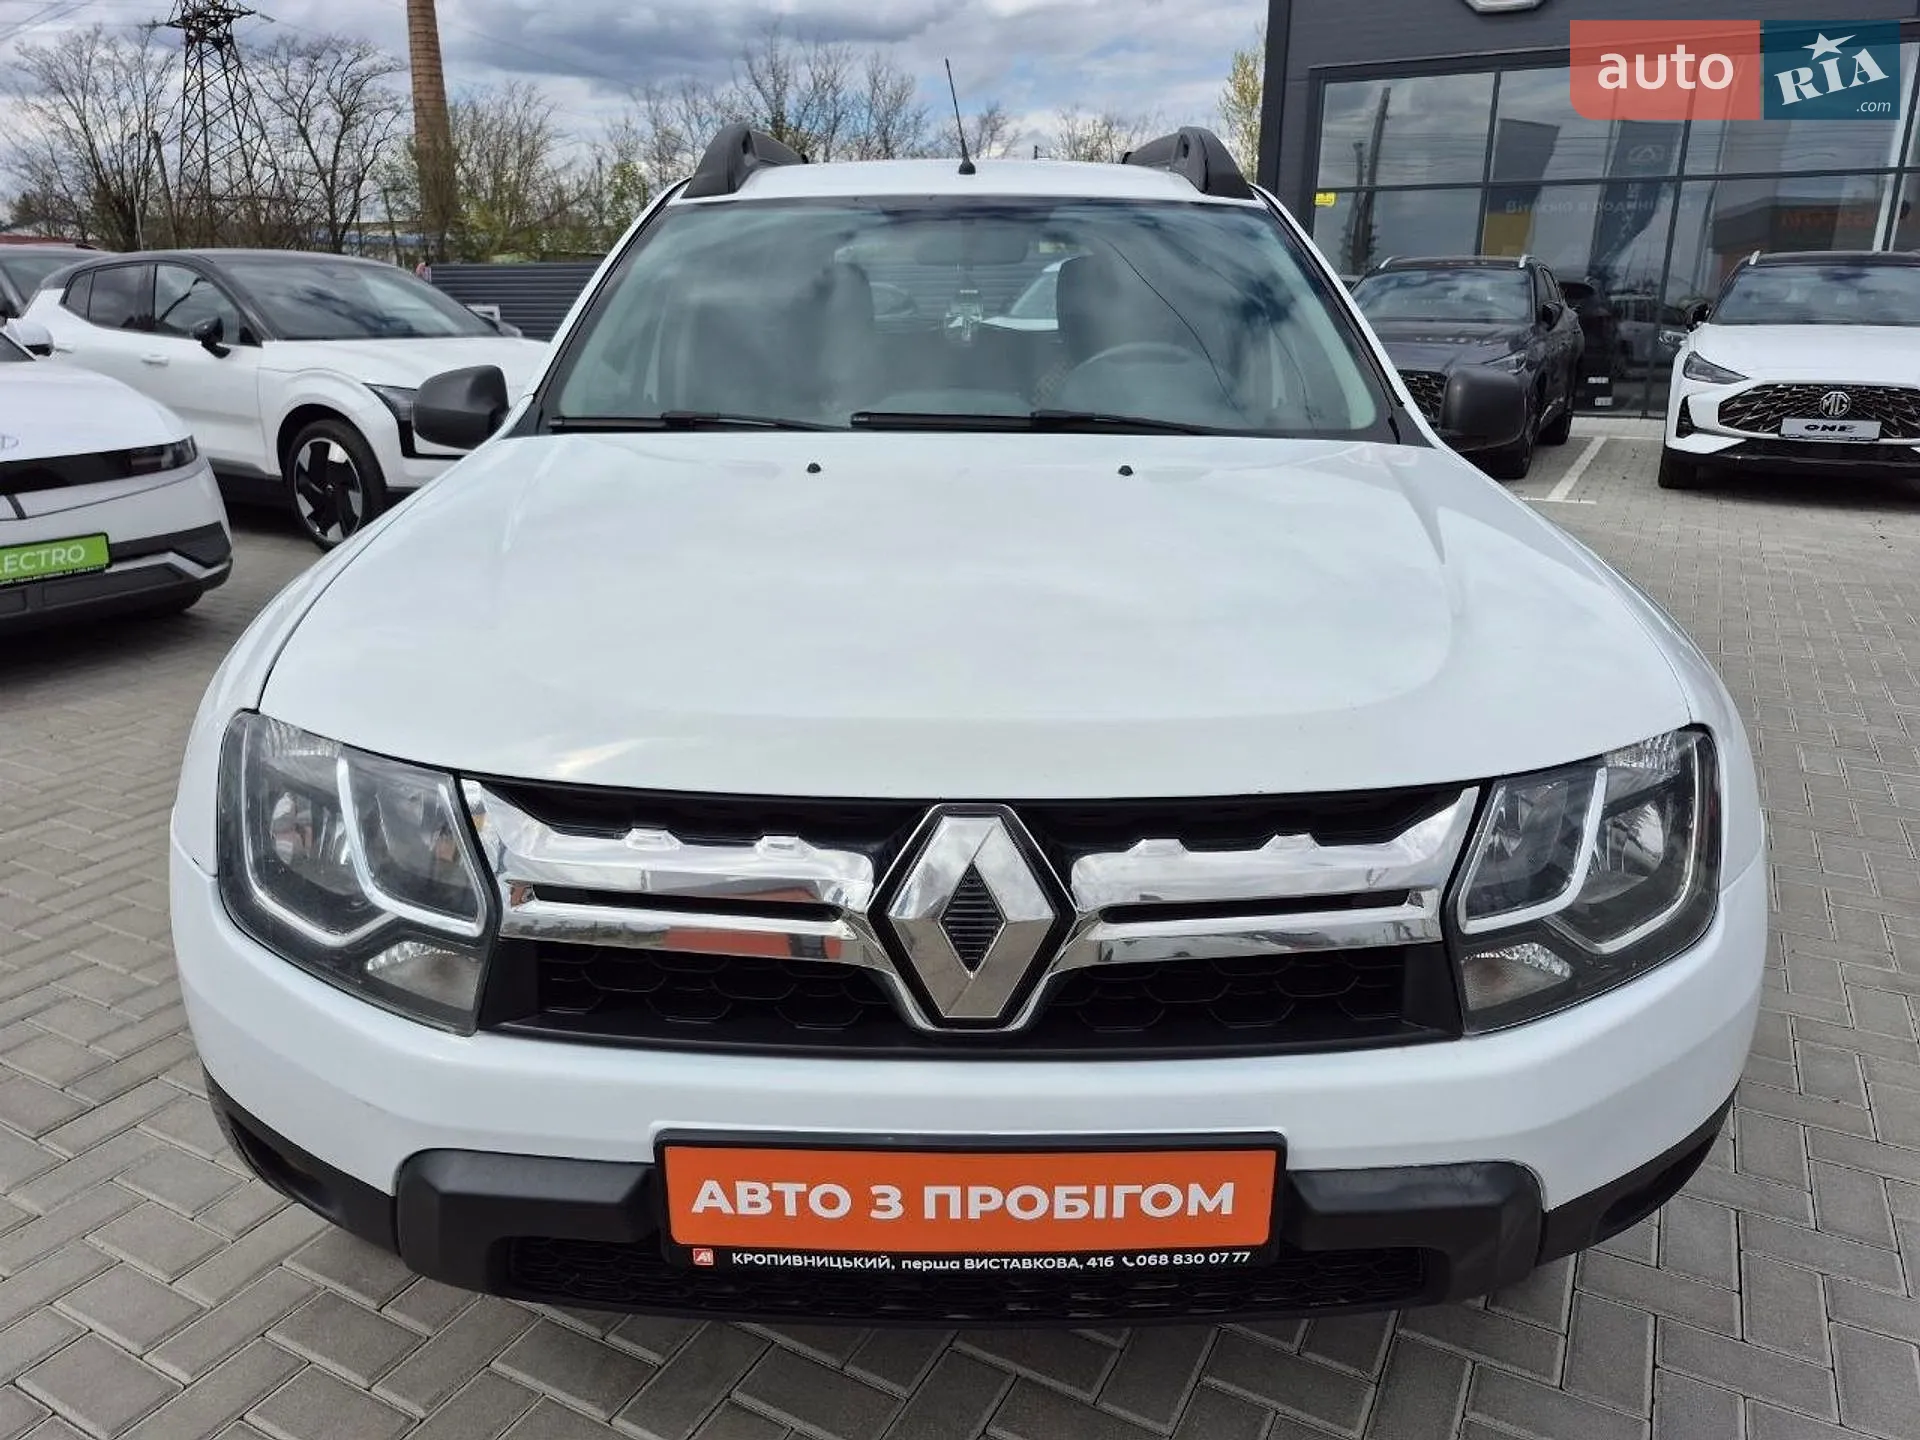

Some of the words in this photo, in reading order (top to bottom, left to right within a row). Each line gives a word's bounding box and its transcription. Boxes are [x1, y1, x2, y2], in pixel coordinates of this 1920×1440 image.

[1821, 393, 1849, 416] MG
[0, 544, 86, 575] ECTRO
[691, 1179, 852, 1219] АВТО
[869, 1183, 904, 1220] З
[923, 1182, 1235, 1221] ПРОБІГОМ
[731, 1253, 896, 1271] КРОПИВНИЦЬКИЙ,
[901, 1259, 960, 1272] перша
[964, 1257, 1083, 1271] ВИСТАВКОВА,
[1136, 1255, 1169, 1266] 068
[1172, 1253, 1206, 1265] 830
